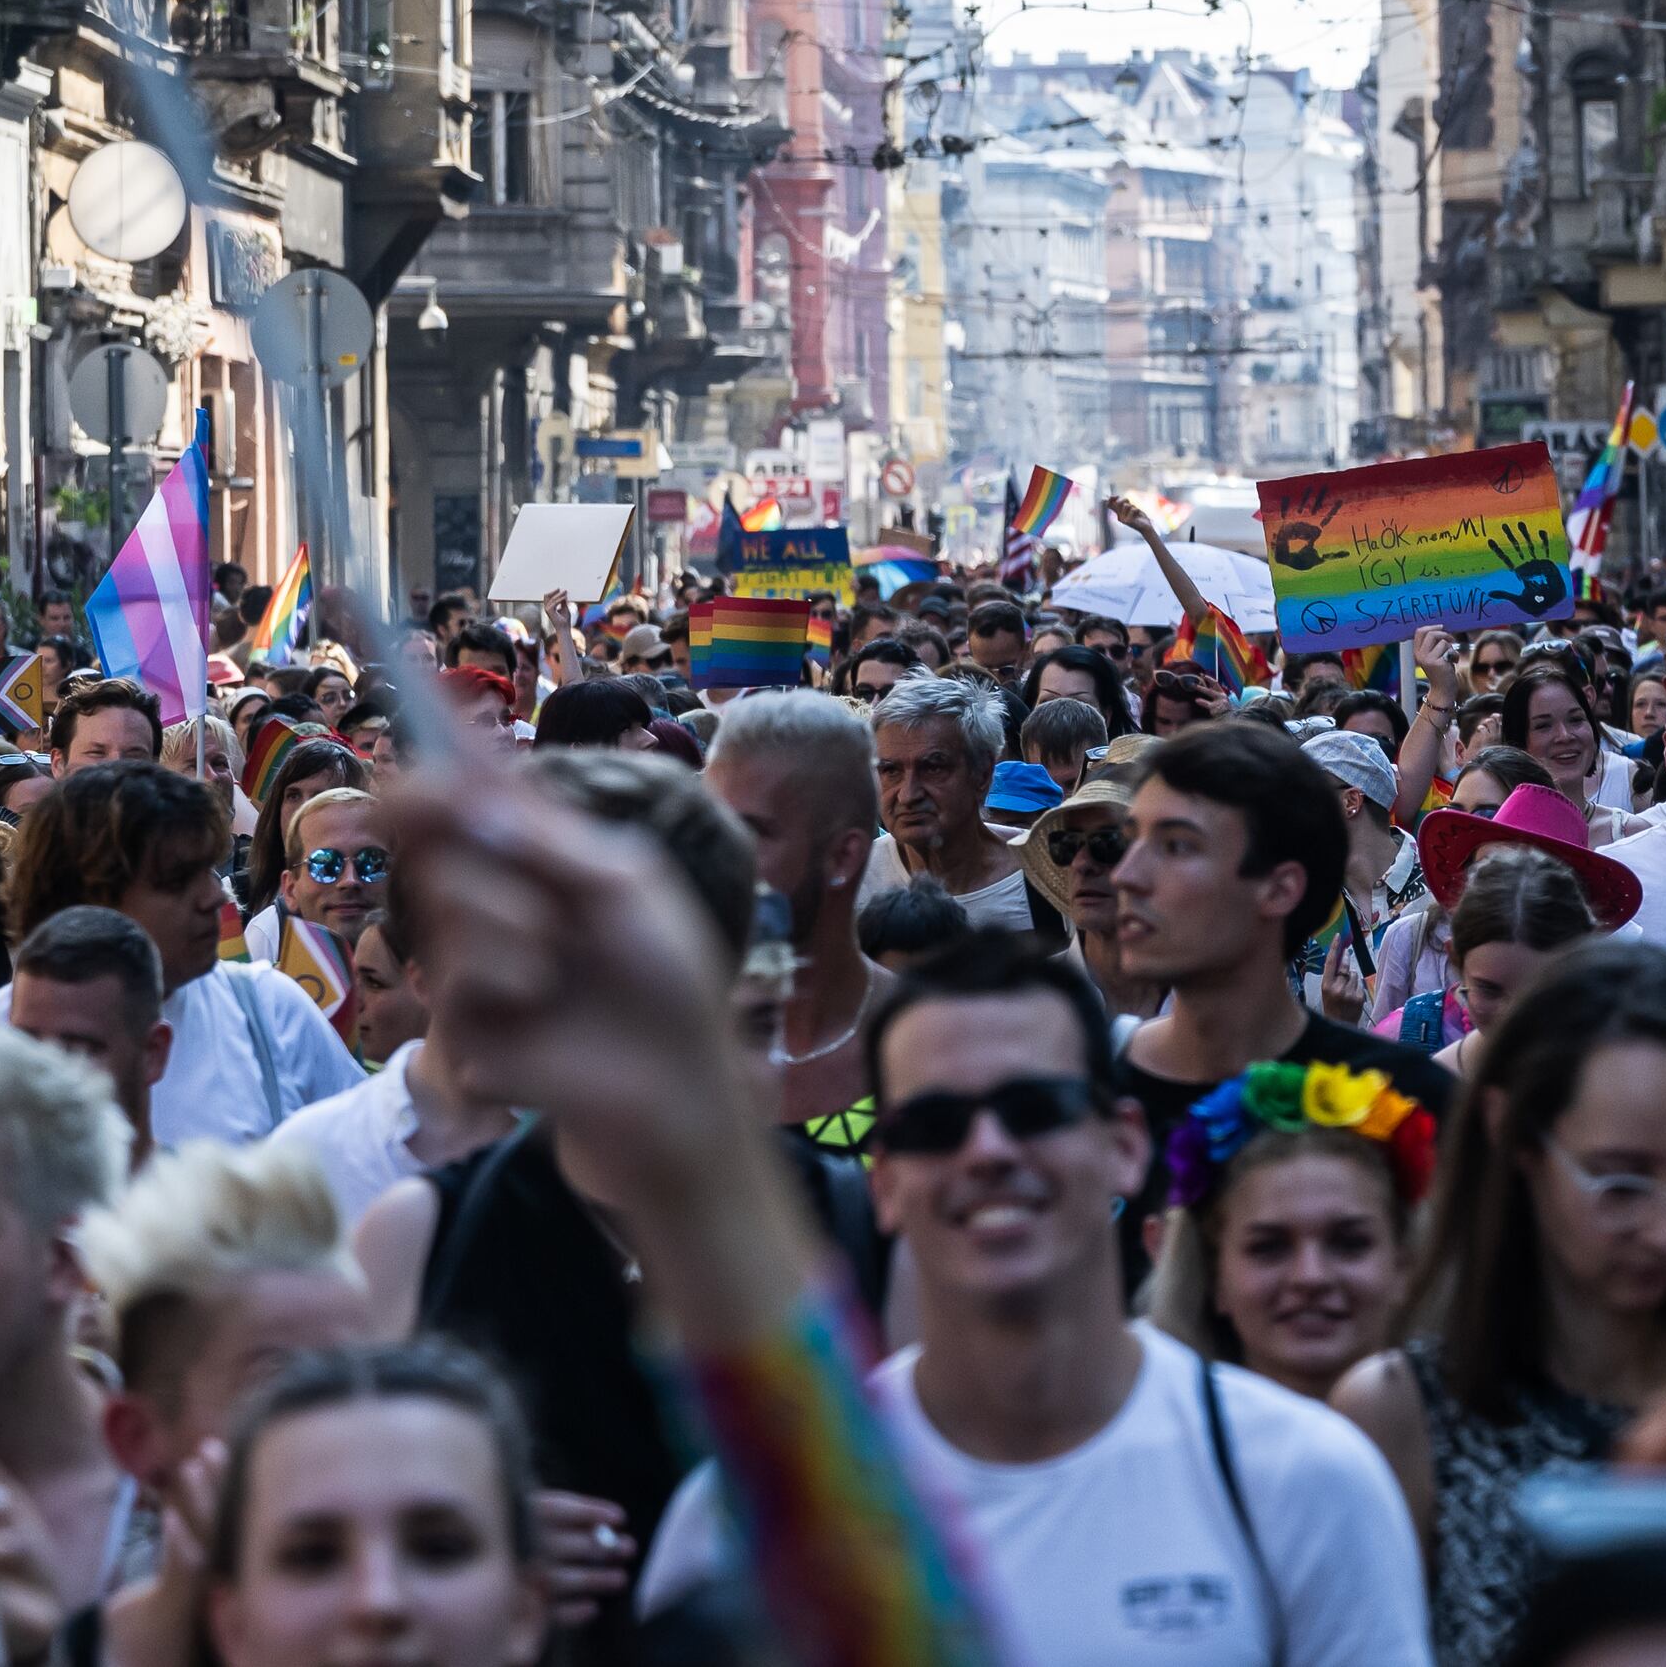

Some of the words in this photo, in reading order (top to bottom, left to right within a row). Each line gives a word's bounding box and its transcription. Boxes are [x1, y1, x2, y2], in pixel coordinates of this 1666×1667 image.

[780, 539, 825, 561] ALL
[1358, 554, 1407, 589] ÍGY
[1355, 586, 1493, 633] SZERETÜNK
